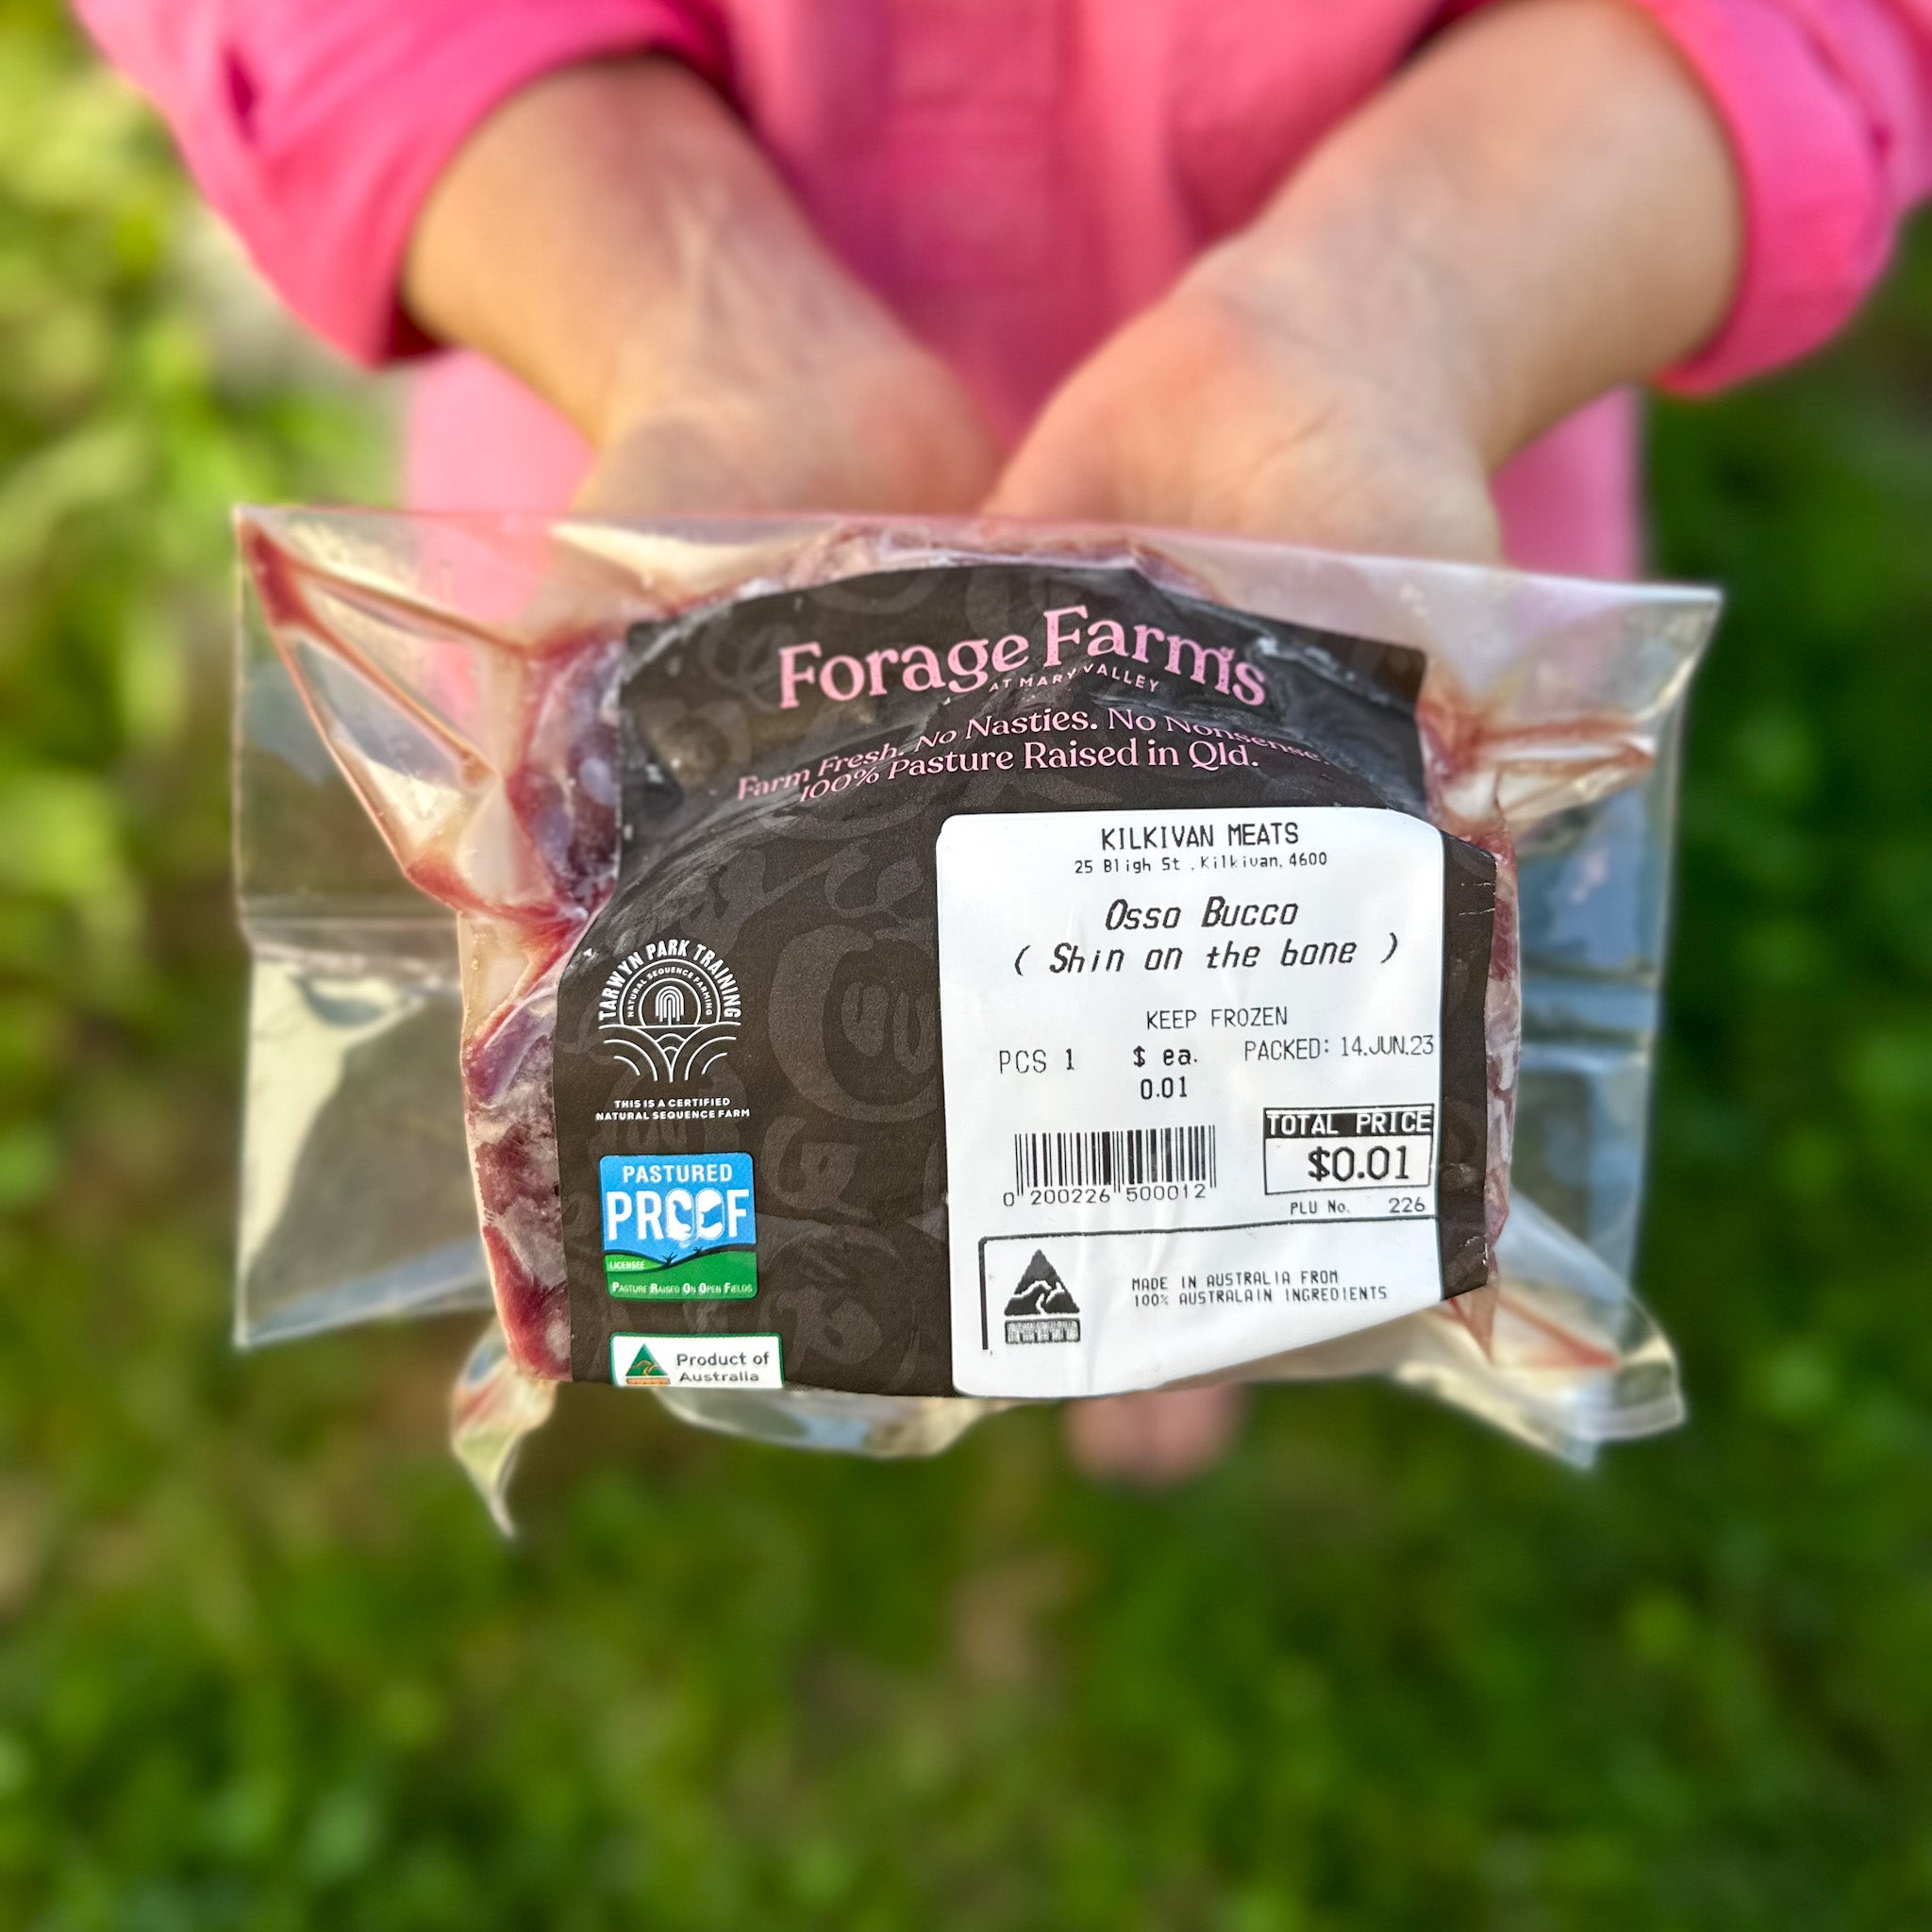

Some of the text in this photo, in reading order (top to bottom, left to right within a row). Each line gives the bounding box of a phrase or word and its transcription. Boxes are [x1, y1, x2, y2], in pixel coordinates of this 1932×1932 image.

[779, 605, 1266, 708] Forage Farms
[989, 663, 1158, 692] AT MARY VALLEY
[738, 769, 810, 800] Farm
[914, 730, 957, 752] No
[965, 708, 1097, 740] Nasties.
[1108, 708, 1156, 731] No
[1165, 716, 1329, 765] Nonsense.
[800, 738, 1259, 802] 100% Pasture Raised in Qld.
[1102, 822, 1299, 850] KILKIVAN MEATS
[1074, 860, 1092, 874] 25
[1104, 858, 1151, 874] Bligh
[1161, 857, 1180, 871] St
[1289, 852, 1327, 866] 4600
[1105, 896, 1299, 930] Osso Bucco
[1014, 932, 1398, 975] ( Shin on the bone )
[598, 940, 741, 1021] TARWYN PARK TRAINING
[627, 966, 712, 1018] NATURAL SEQUENCE FARMING
[1146, 1007, 1289, 1029] KEEP FROZEN
[1000, 1047, 1074, 1074] PCS 1
[1133, 1045, 1197, 1067] $ ea.
[1244, 1035, 1434, 1061] PACKED: 14.JUN.23
[1140, 1077, 1187, 1099] 0.01
[595, 1108, 750, 1121] NATURAL SEQUENCE FARM
[614, 1097, 730, 1108] THIS IS A CERTIFIED
[1266, 1109, 1432, 1136] TOTAL PRICE
[623, 1163, 732, 1183] PASTURED
[1307, 1145, 1410, 1182] $0.01
[1003, 1185, 1207, 1208] 0 200226 500012
[1291, 1198, 1426, 1214] PLU No. 226
[606, 1187, 750, 1242] PROOF
[1132, 1270, 1339, 1291] MADE IN AUSTRALIA FROM
[1135, 1286, 1387, 1307] 100% AUSTRALAIN INGREDIENTS
[676, 1351, 769, 1366] Product of
[679, 1371, 759, 1382] Australia
